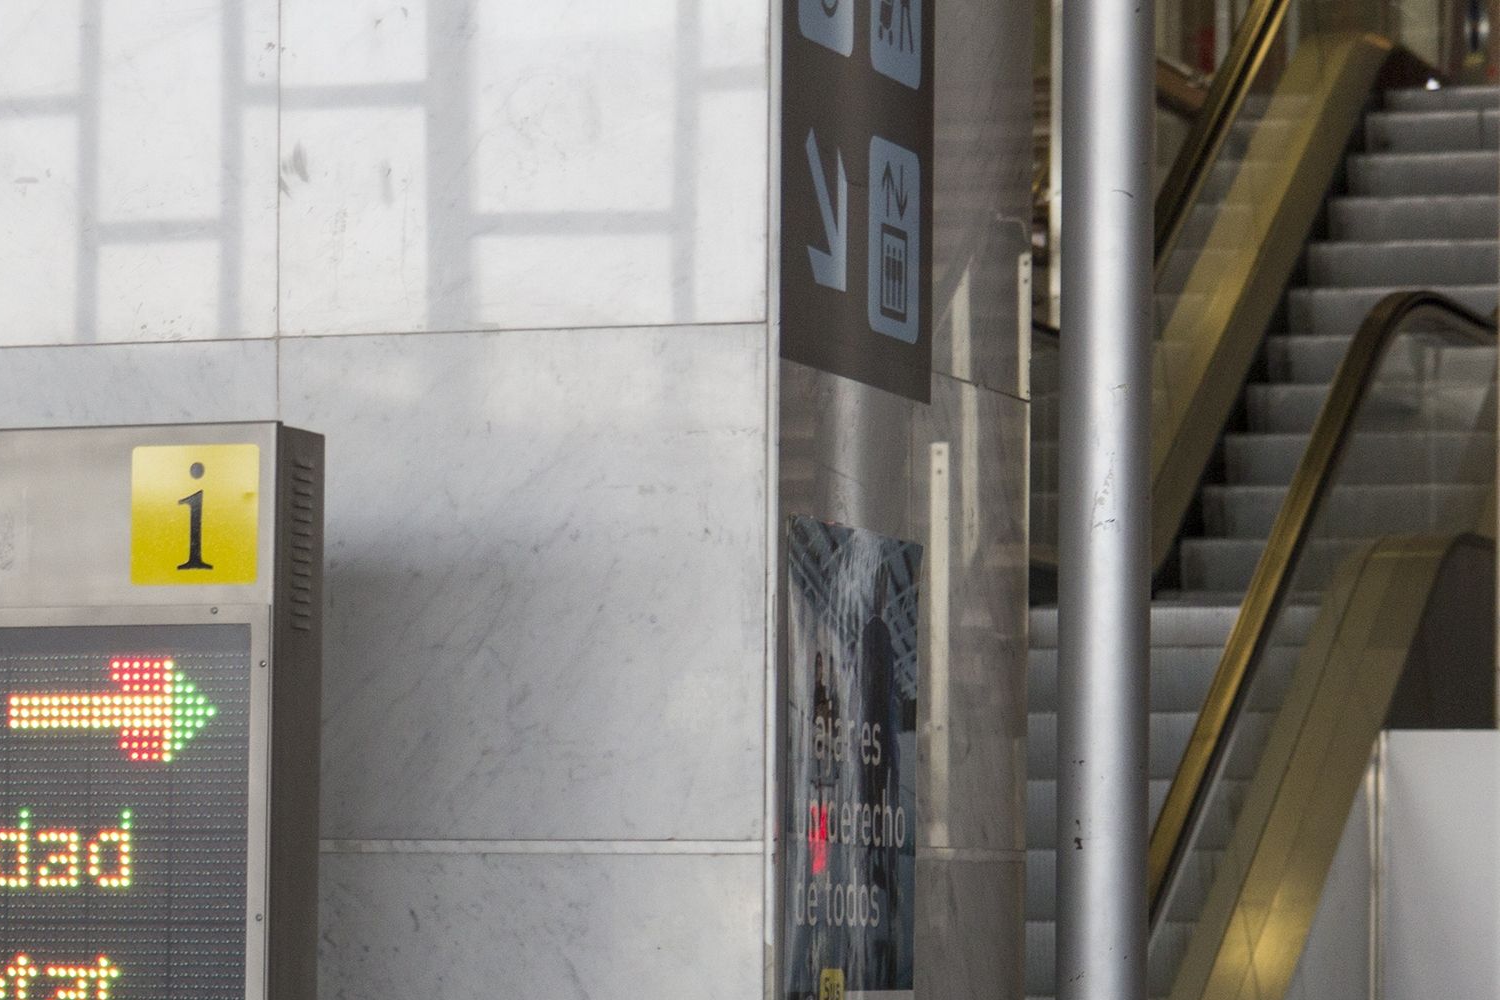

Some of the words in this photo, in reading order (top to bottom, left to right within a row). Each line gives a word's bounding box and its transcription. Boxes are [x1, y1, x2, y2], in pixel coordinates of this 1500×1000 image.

[860, 721, 882, 766] es
[827, 783, 906, 849] derecho
[795, 865, 819, 927] de
[824, 866, 880, 928] todos
